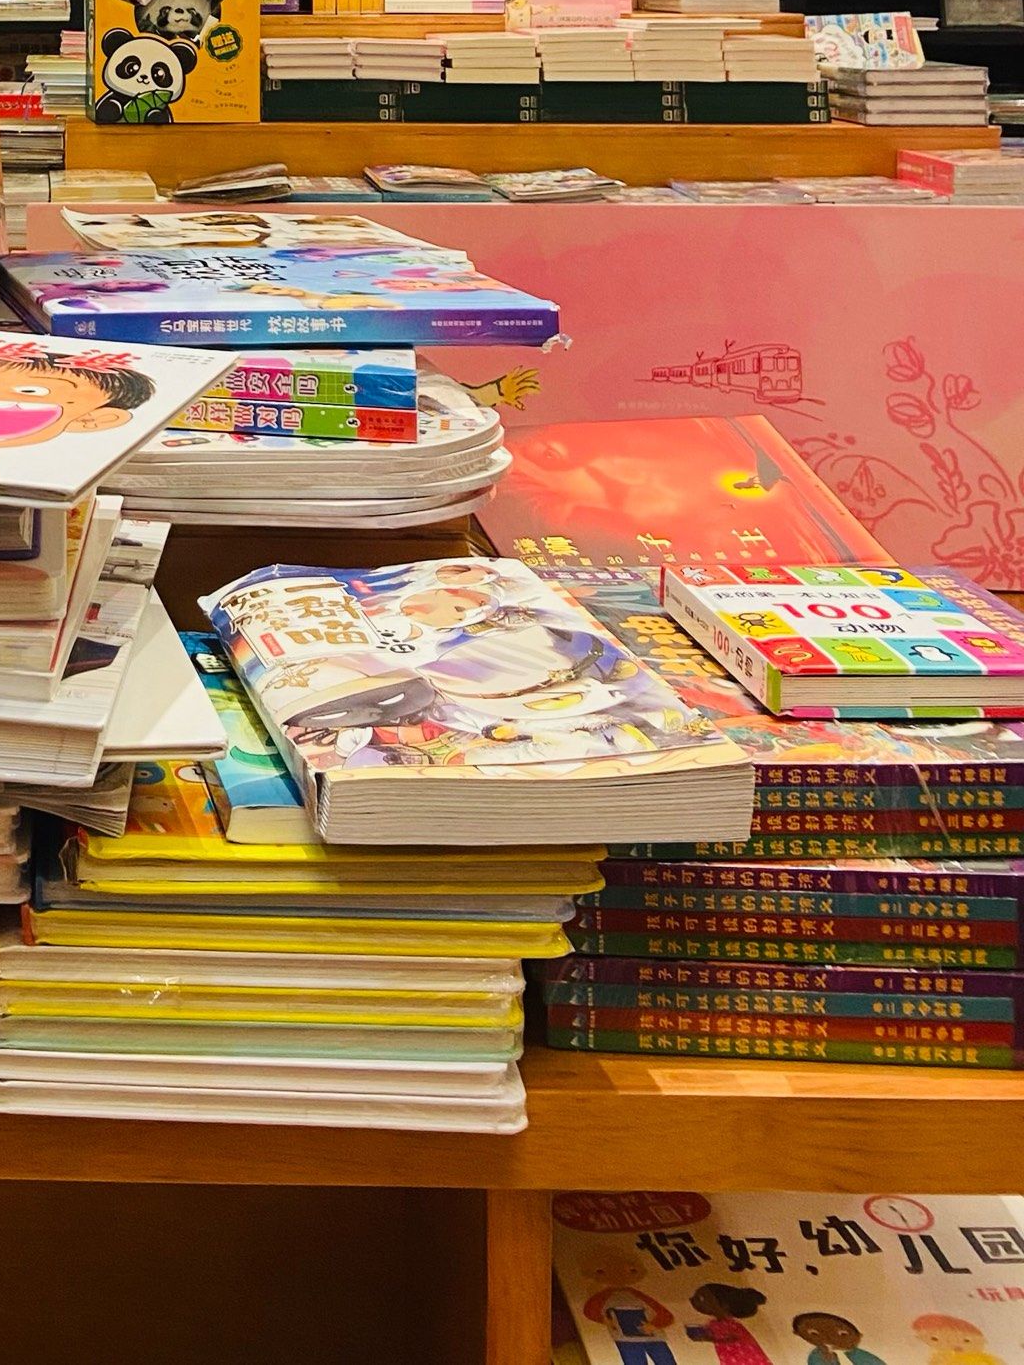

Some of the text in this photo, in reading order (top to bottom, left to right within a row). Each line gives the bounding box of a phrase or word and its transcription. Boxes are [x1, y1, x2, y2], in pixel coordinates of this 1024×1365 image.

[159, 318, 253, 333] 小马宝莉新世代
[267, 315, 347, 335] 枕边故事书
[216, 370, 320, 397] 做安全吗
[184, 402, 304, 431] 这样做对吗
[712, 589, 883, 603] 我的第一本认知书
[831, 621, 908, 637] 动物
[642, 867, 833, 890] 孩子可以读的封神演义
[644, 892, 834, 915] 孩子可以读的封神演义
[646, 915, 835, 936] 孩子可以读的封神演义
[648, 938, 837, 961] 孩子可以读的封神演义
[638, 966, 827, 989] 孩子可以读的封神演义
[637, 991, 827, 1014] 孩子可以读的封神演义
[639, 1014, 828, 1038] 孩子可以读的封神演义
[637, 1034, 827, 1058] 孩子可以读的封神演义
